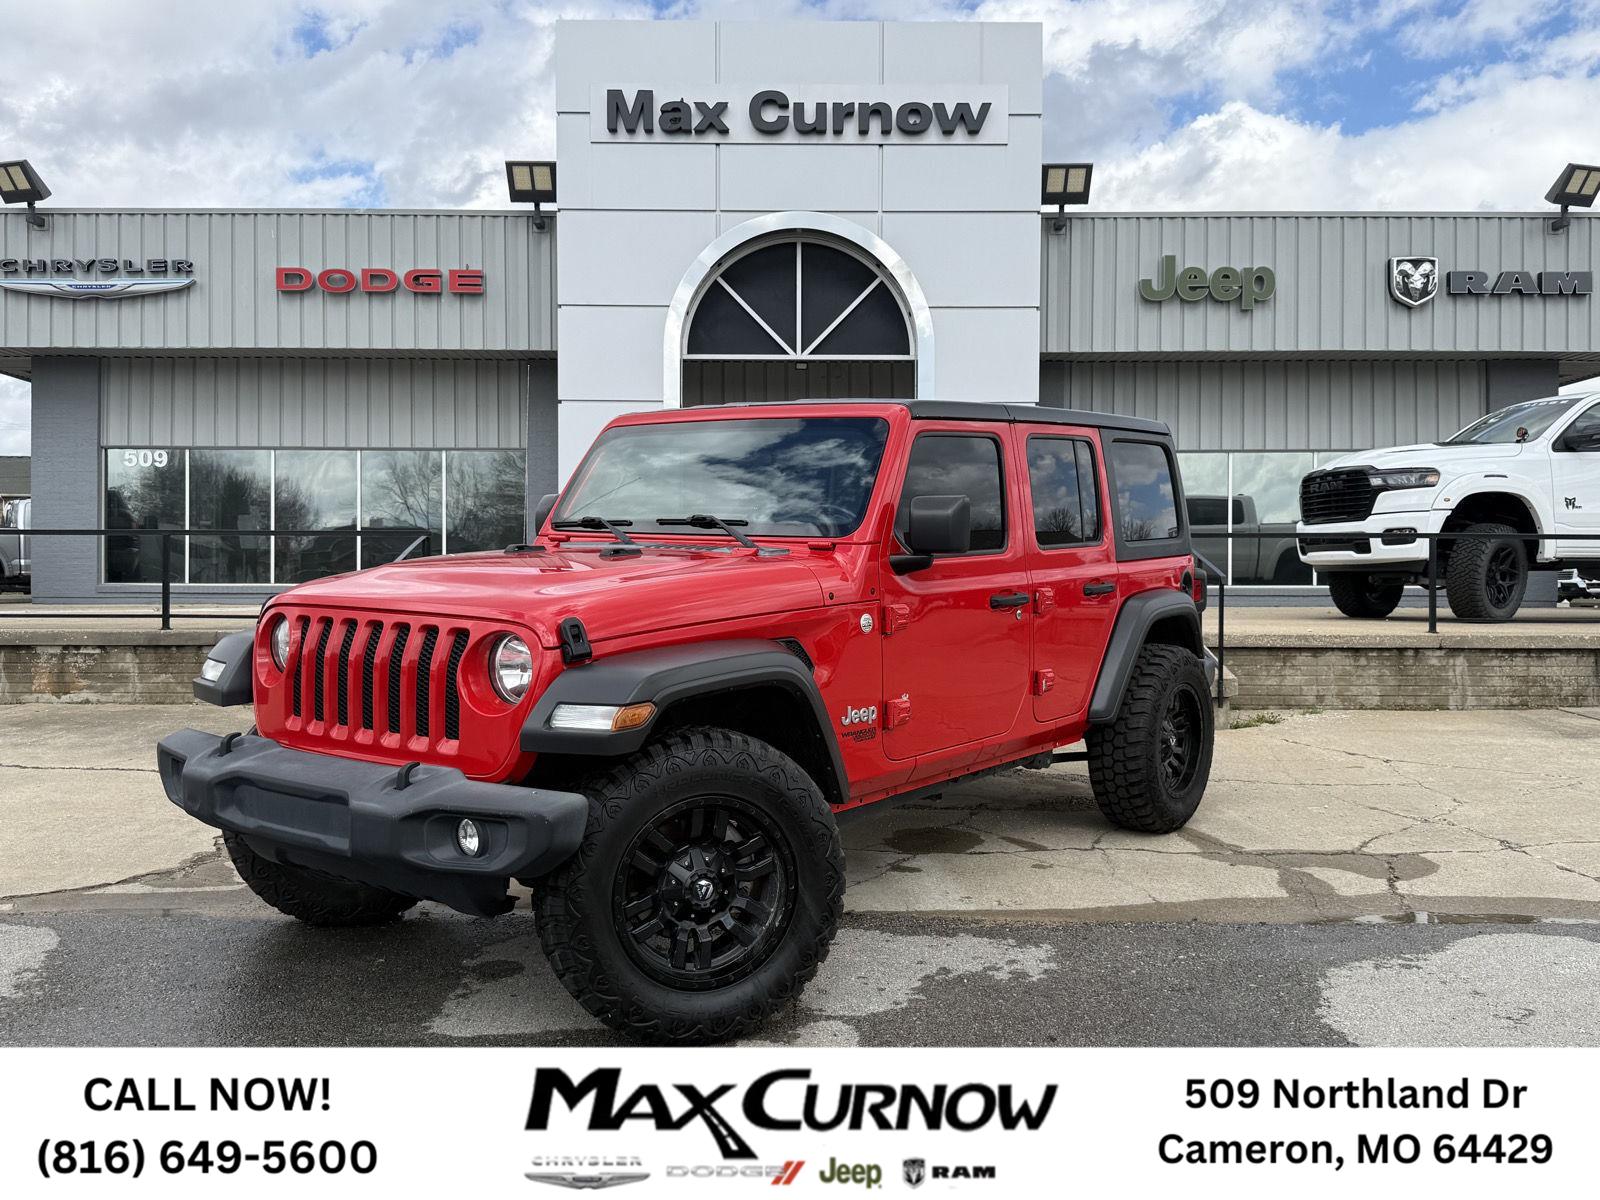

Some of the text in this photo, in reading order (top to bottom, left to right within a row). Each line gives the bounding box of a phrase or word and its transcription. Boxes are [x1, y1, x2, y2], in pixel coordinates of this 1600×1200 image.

[606, 88, 992, 136] Max Curnow
[0, 258, 195, 273] CHRYSLER
[275, 266, 485, 294] DODGE
[1138, 254, 1277, 311] Jeep
[1447, 270, 1593, 297] RAM
[122, 449, 169, 468] 509
[1309, 480, 1343, 493] RAM
[841, 705, 878, 726] Jeep
